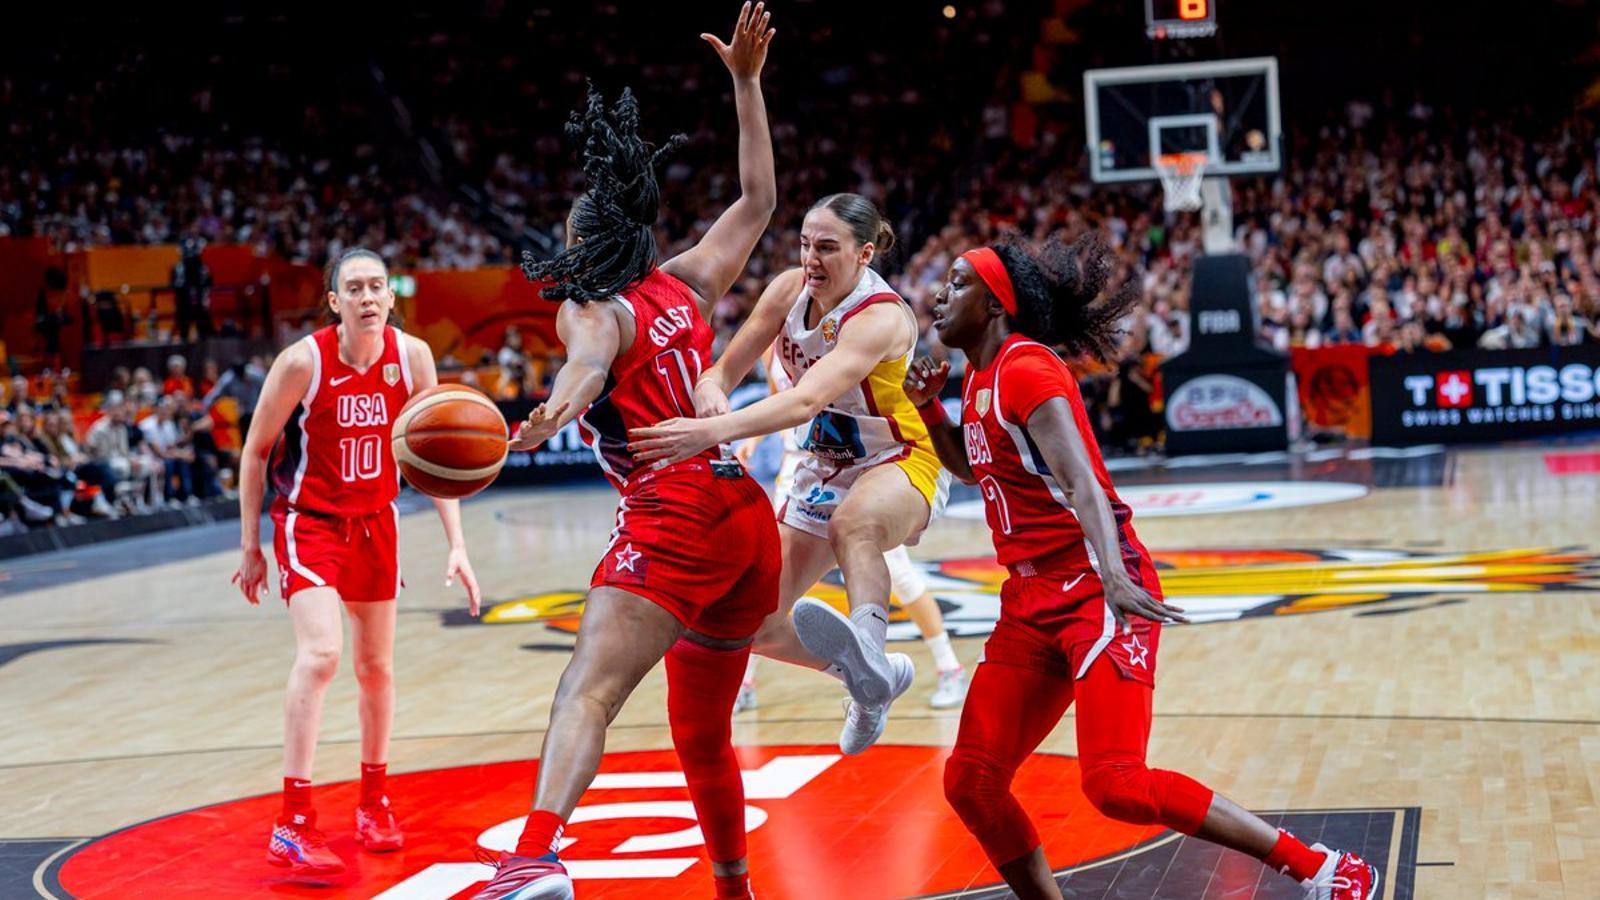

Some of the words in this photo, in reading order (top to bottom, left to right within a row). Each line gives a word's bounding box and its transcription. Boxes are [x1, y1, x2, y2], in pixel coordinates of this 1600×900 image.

[1198, 309, 1240, 334] FIBA
[656, 348, 702, 417] 1
[1474, 363, 1600, 407] TISS
[337, 393, 388, 427] USA
[1402, 408, 1461, 428] SWISS
[1466, 404, 1555, 425] WATCHES
[340, 434, 381, 482] 10
